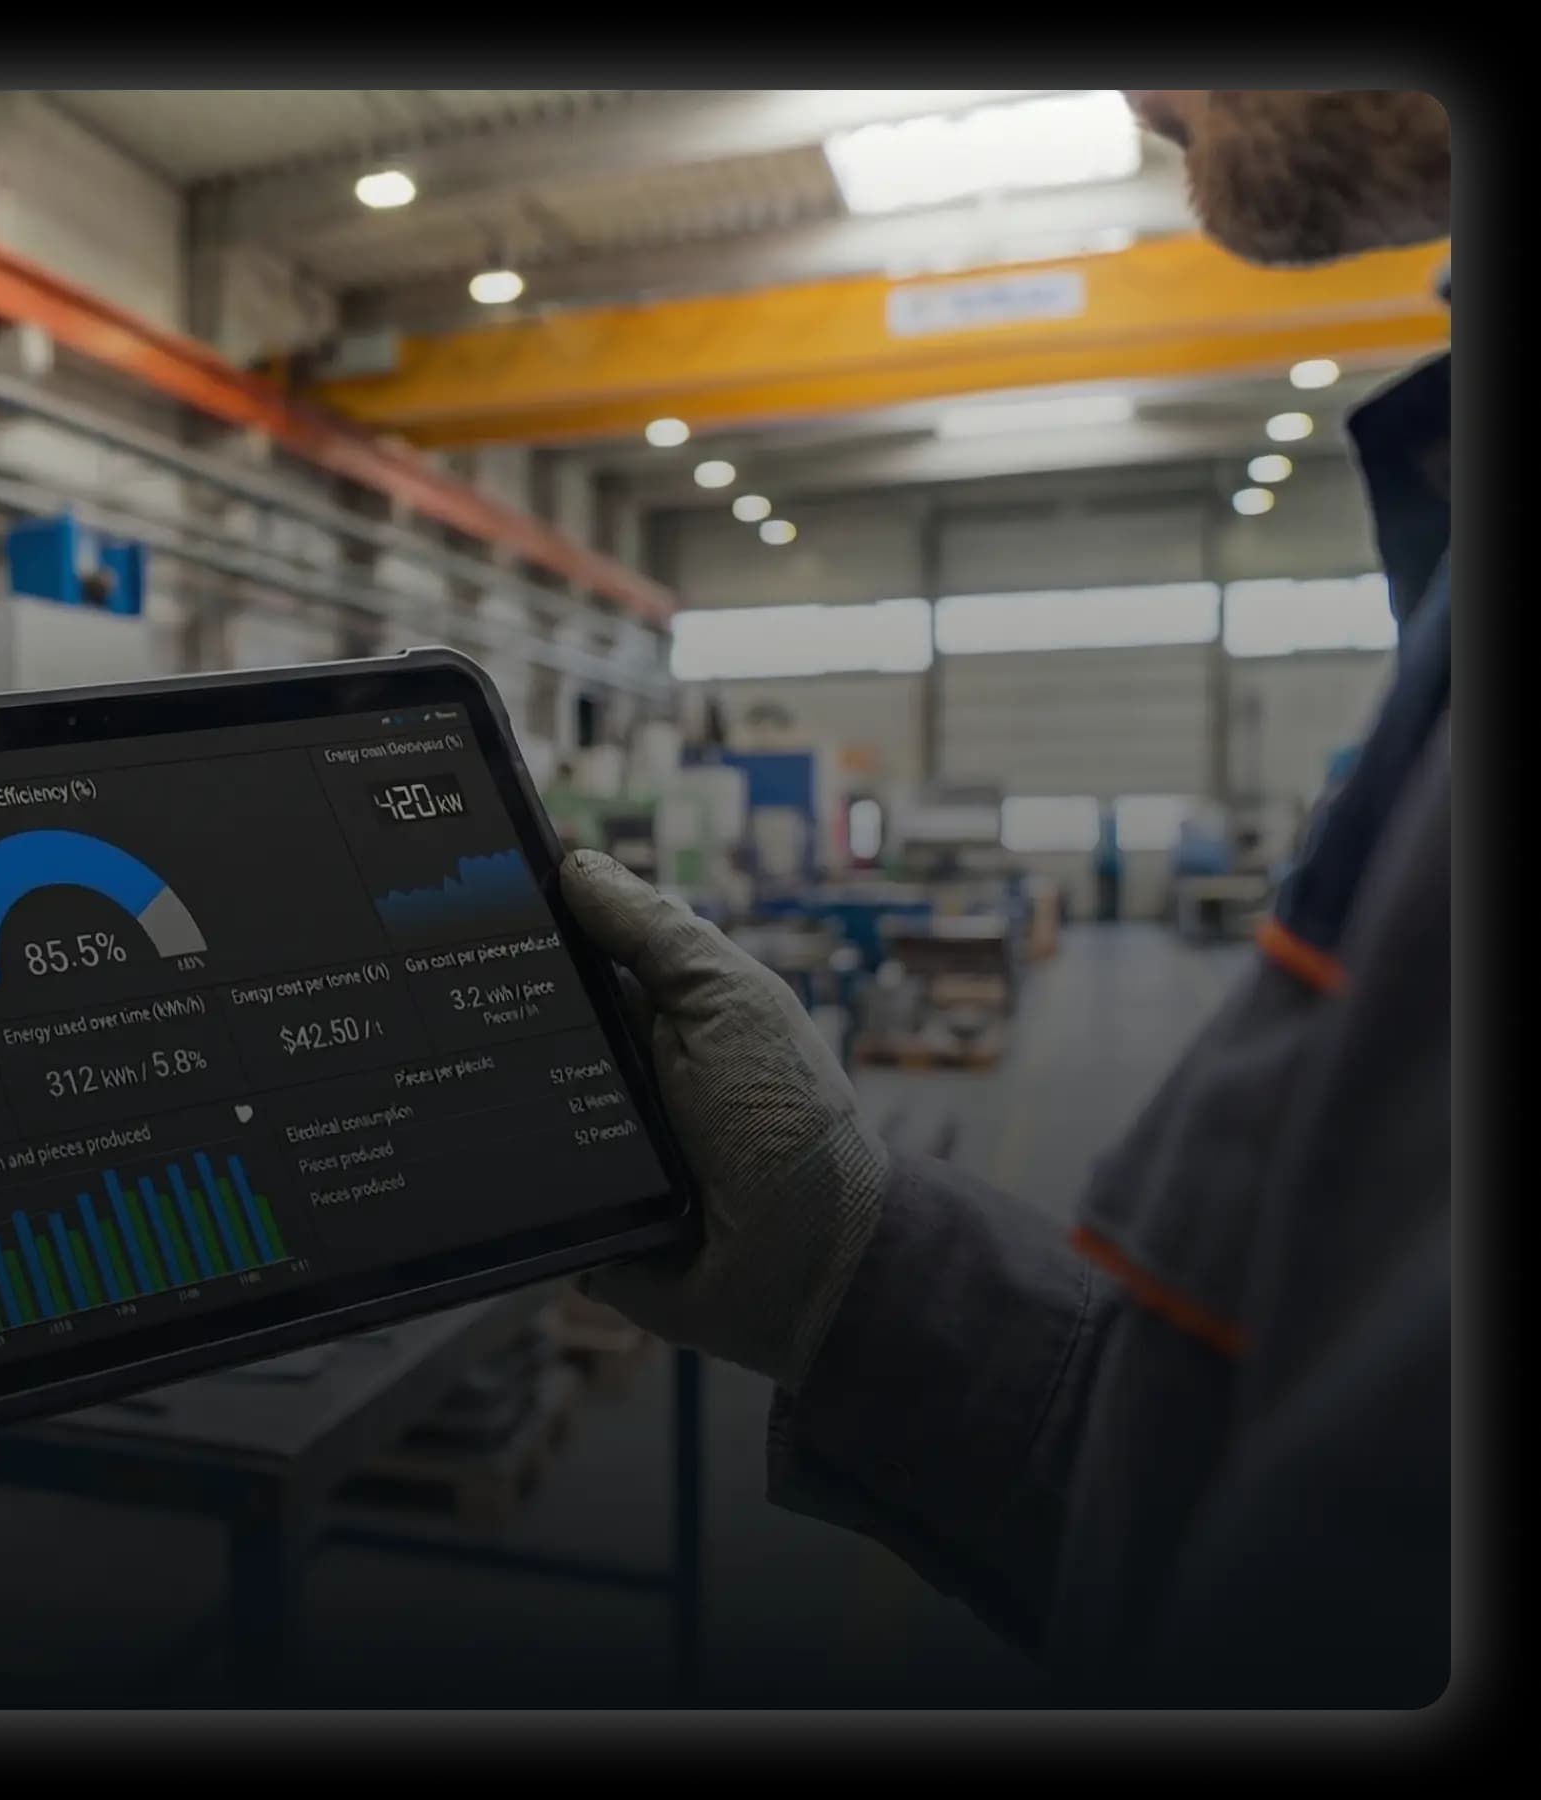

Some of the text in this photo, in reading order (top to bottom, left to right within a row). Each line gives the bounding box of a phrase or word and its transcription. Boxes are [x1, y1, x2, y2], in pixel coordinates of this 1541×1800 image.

[70, 778, 97, 800] (%)
[374, 783, 463, 820] 420 kW
[24, 932, 127, 976] 85.5%
[477, 944, 508, 964] piece
[276, 980, 304, 997] cost
[305, 977, 324, 996] per
[450, 986, 484, 1010] 3.2
[522, 980, 555, 1000] piece
[3, 994, 206, 1045] Energy used over time (kWh/h)
[279, 1016, 360, 1055] $42.50
[46, 1064, 99, 1098] 312
[99, 1066, 138, 1089] kWh
[152, 1049, 207, 1078] 5.8%
[286, 1102, 414, 1143] Electrical consumption
[8, 1147, 35, 1169] and
[38, 1141, 85, 1168] pieces
[86, 1124, 152, 1155] produced
[299, 1140, 394, 1175] Pieces produced
[310, 1170, 407, 1208] Pieces produced
